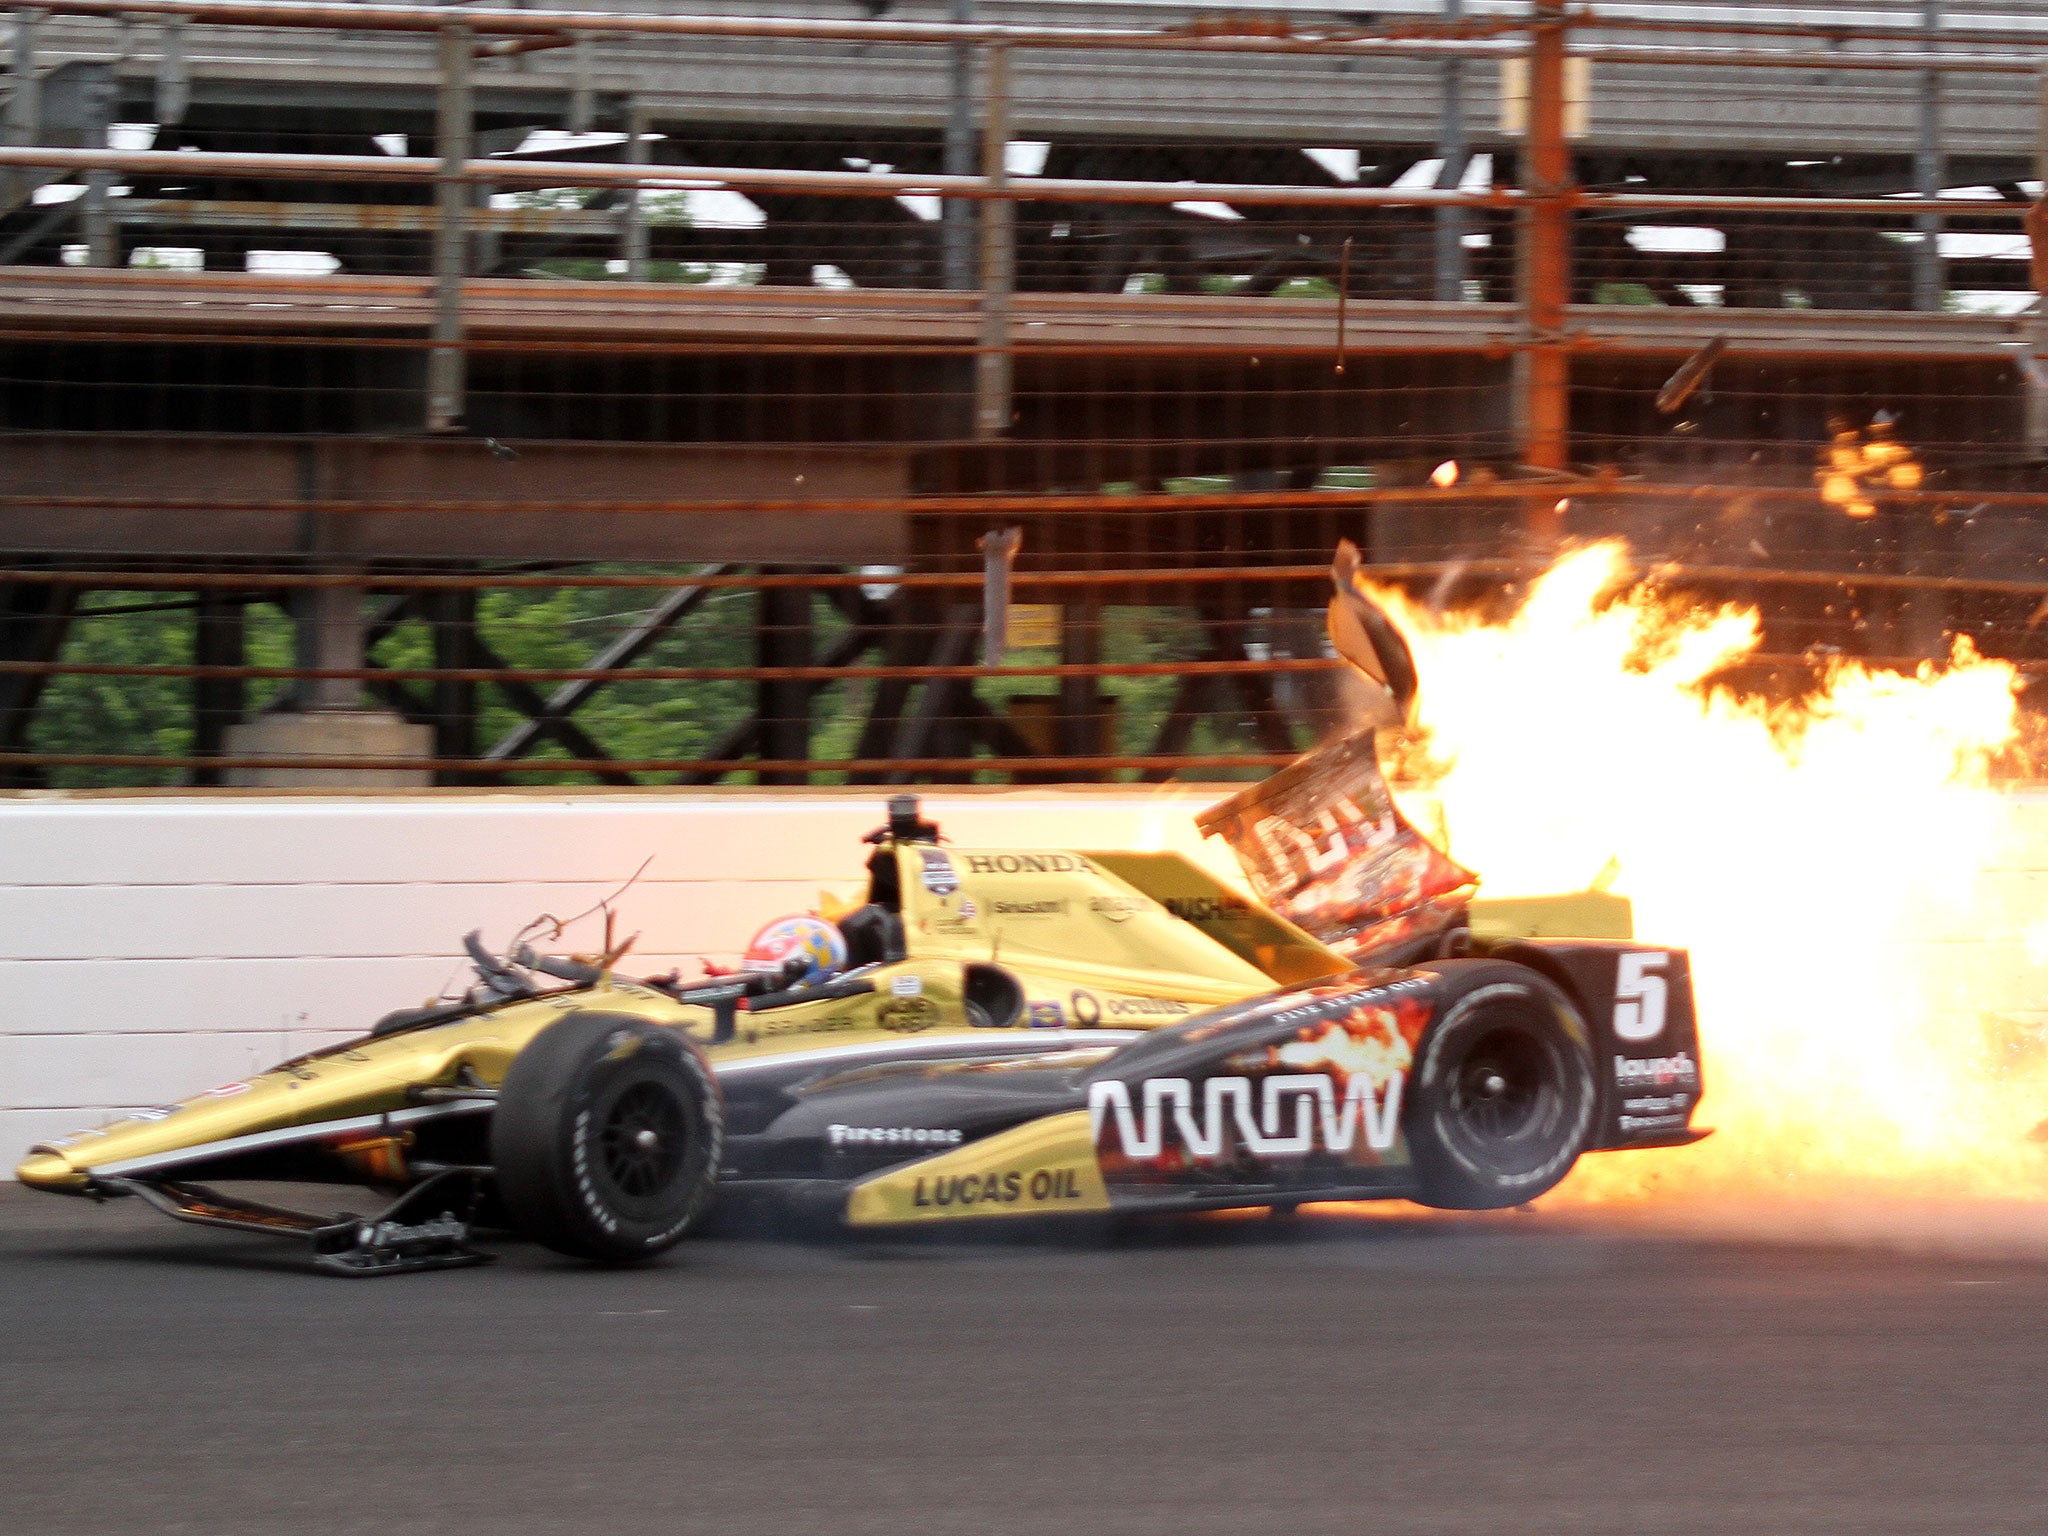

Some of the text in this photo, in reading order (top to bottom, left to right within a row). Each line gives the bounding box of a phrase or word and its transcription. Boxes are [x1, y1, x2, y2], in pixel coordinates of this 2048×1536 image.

[966, 854, 1099, 876] HONDA
[1272, 977, 1431, 1024] FIVE YEARS OUT
[1613, 951, 1669, 1040] 5
[827, 1123, 963, 1145] Firestone
[1089, 1069, 1405, 1157] ARROW
[913, 1168, 1081, 1207] LUCAS OIL
